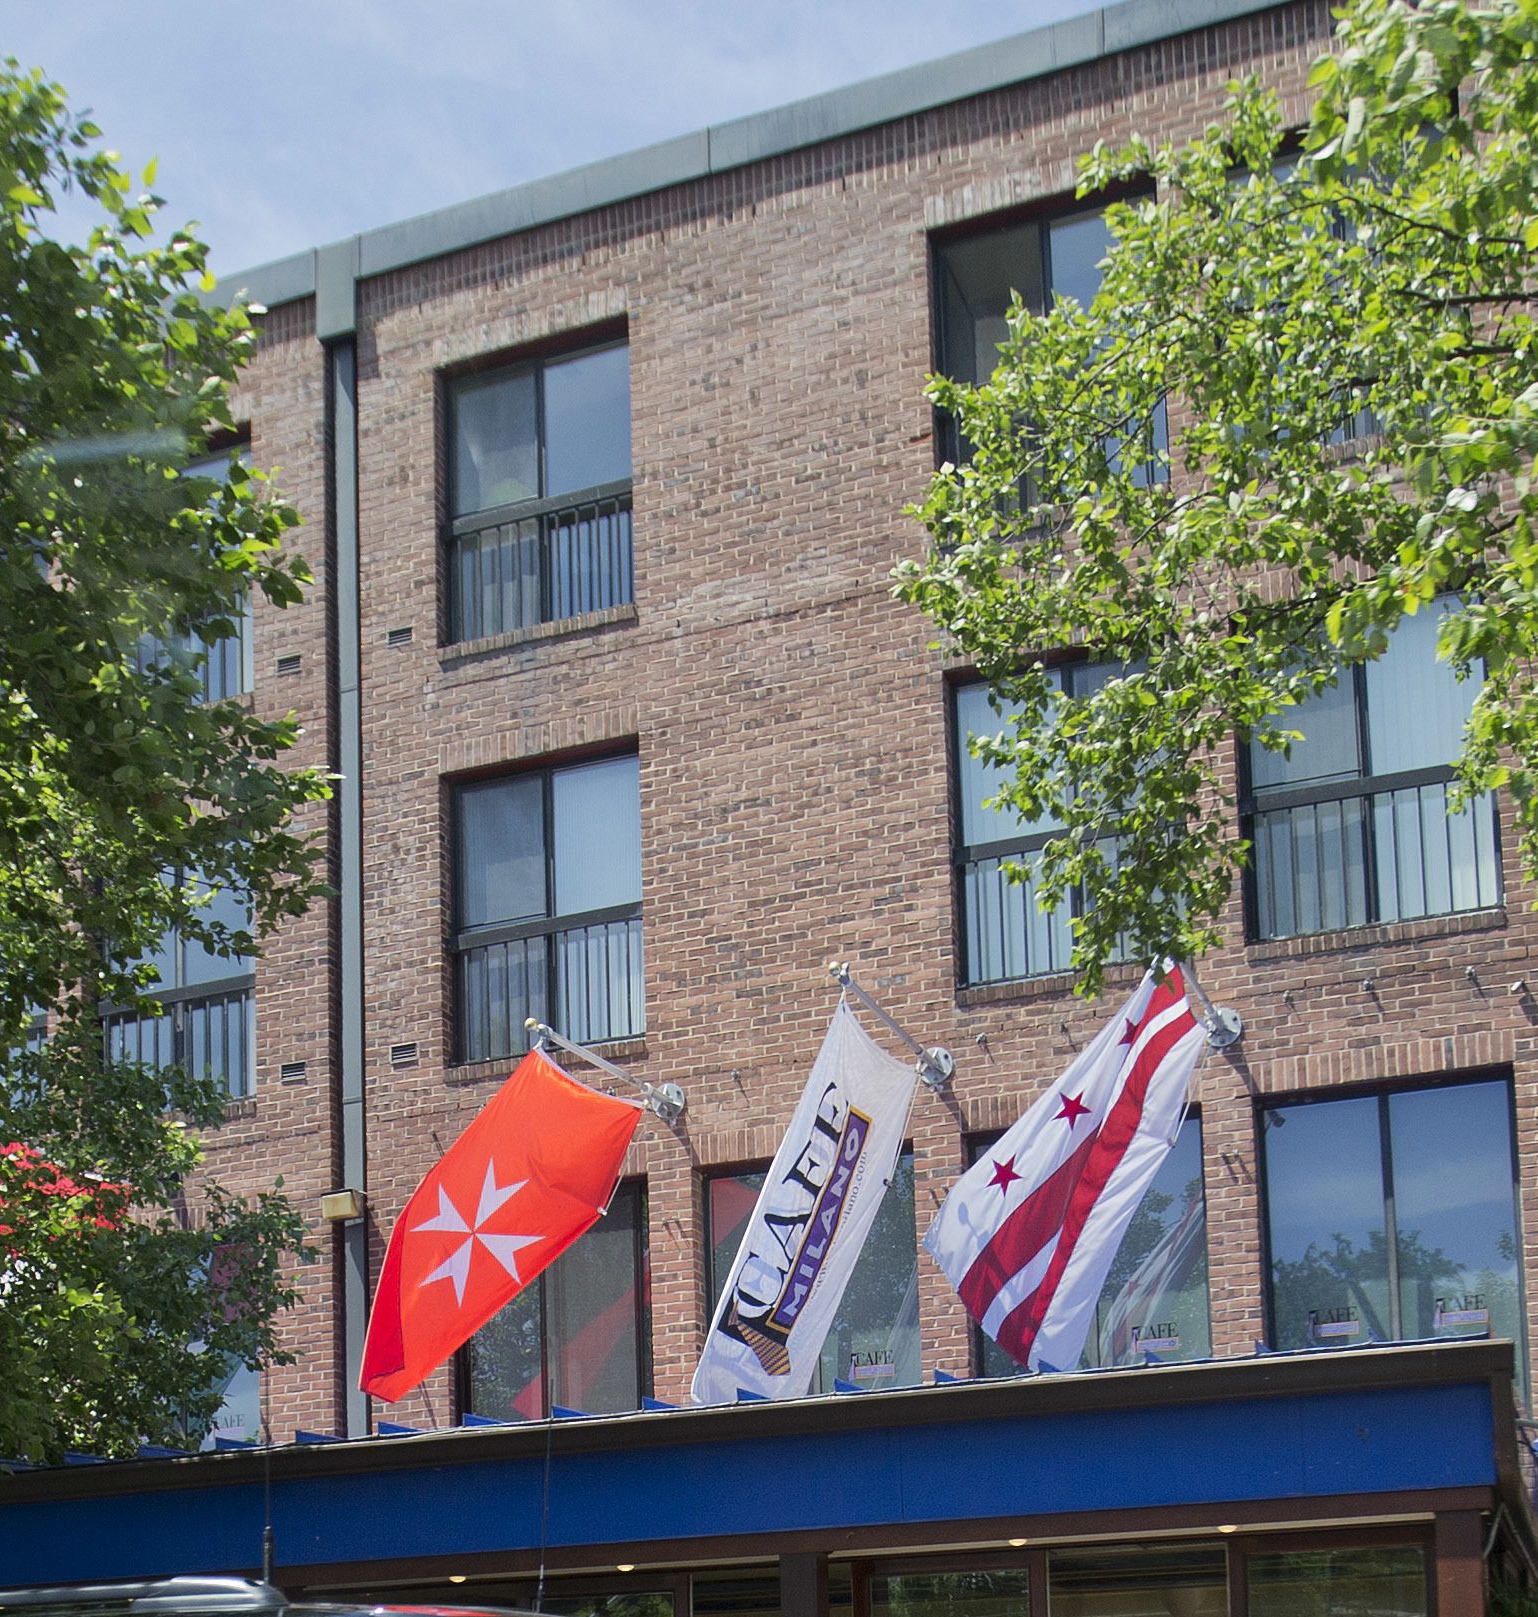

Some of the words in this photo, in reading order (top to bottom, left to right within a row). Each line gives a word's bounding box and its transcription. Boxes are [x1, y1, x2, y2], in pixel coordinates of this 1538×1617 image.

[733, 1082, 849, 1318] CAFE
[782, 1126, 861, 1318] MILANO
[855, 1350, 895, 1367] CAFE
